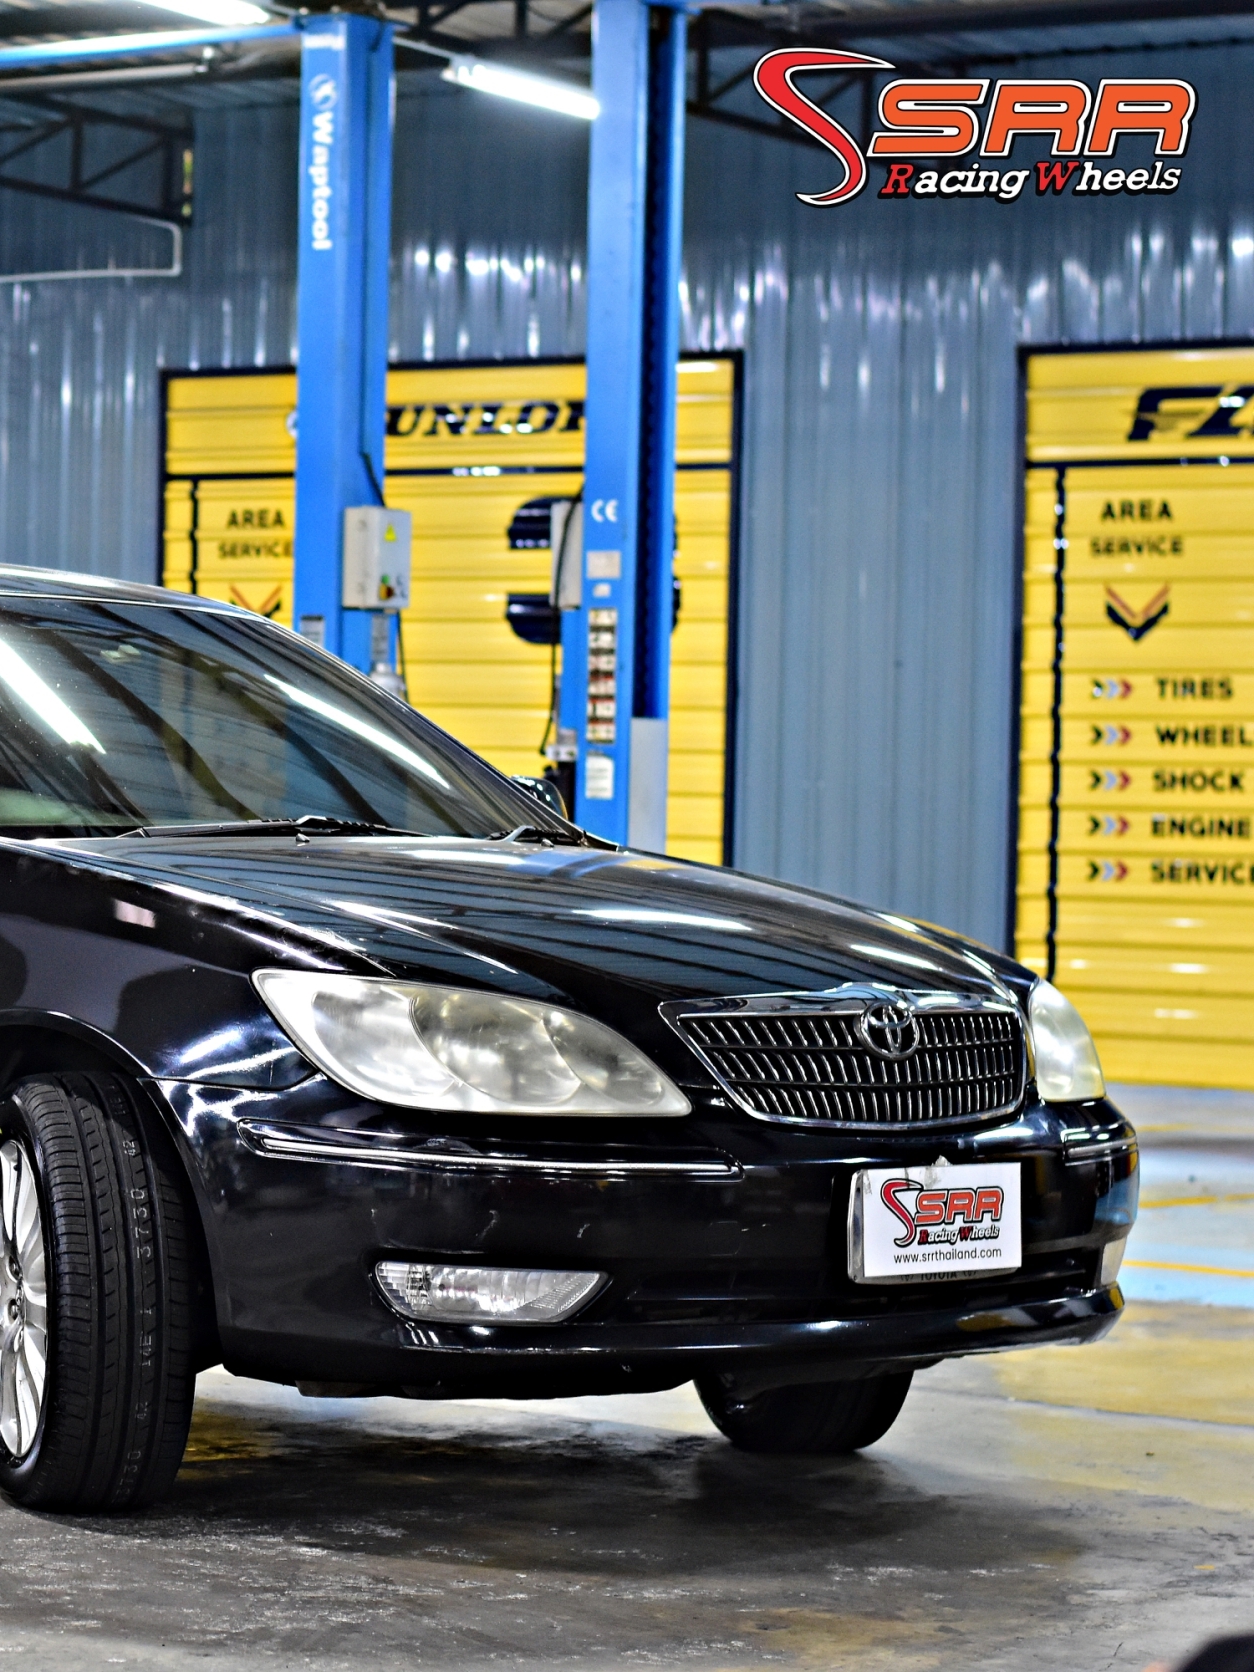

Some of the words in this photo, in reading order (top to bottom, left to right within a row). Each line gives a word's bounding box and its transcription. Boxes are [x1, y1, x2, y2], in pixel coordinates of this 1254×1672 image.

[227, 509, 285, 528] AREA
[591, 499, 617, 522] CE
[1100, 499, 1173, 521] AREA
[1090, 536, 1184, 557] SERVICE
[1156, 677, 1233, 700] TIRES
[1152, 770, 1245, 792] SHOCK
[1152, 814, 1251, 839] ENGINE
[130, 1188, 151, 1259] 3730
[918, 1227, 960, 1246] Racing
[959, 1224, 1001, 1242] Wheels
[894, 1248, 1002, 1264] www.srrthailand.com
